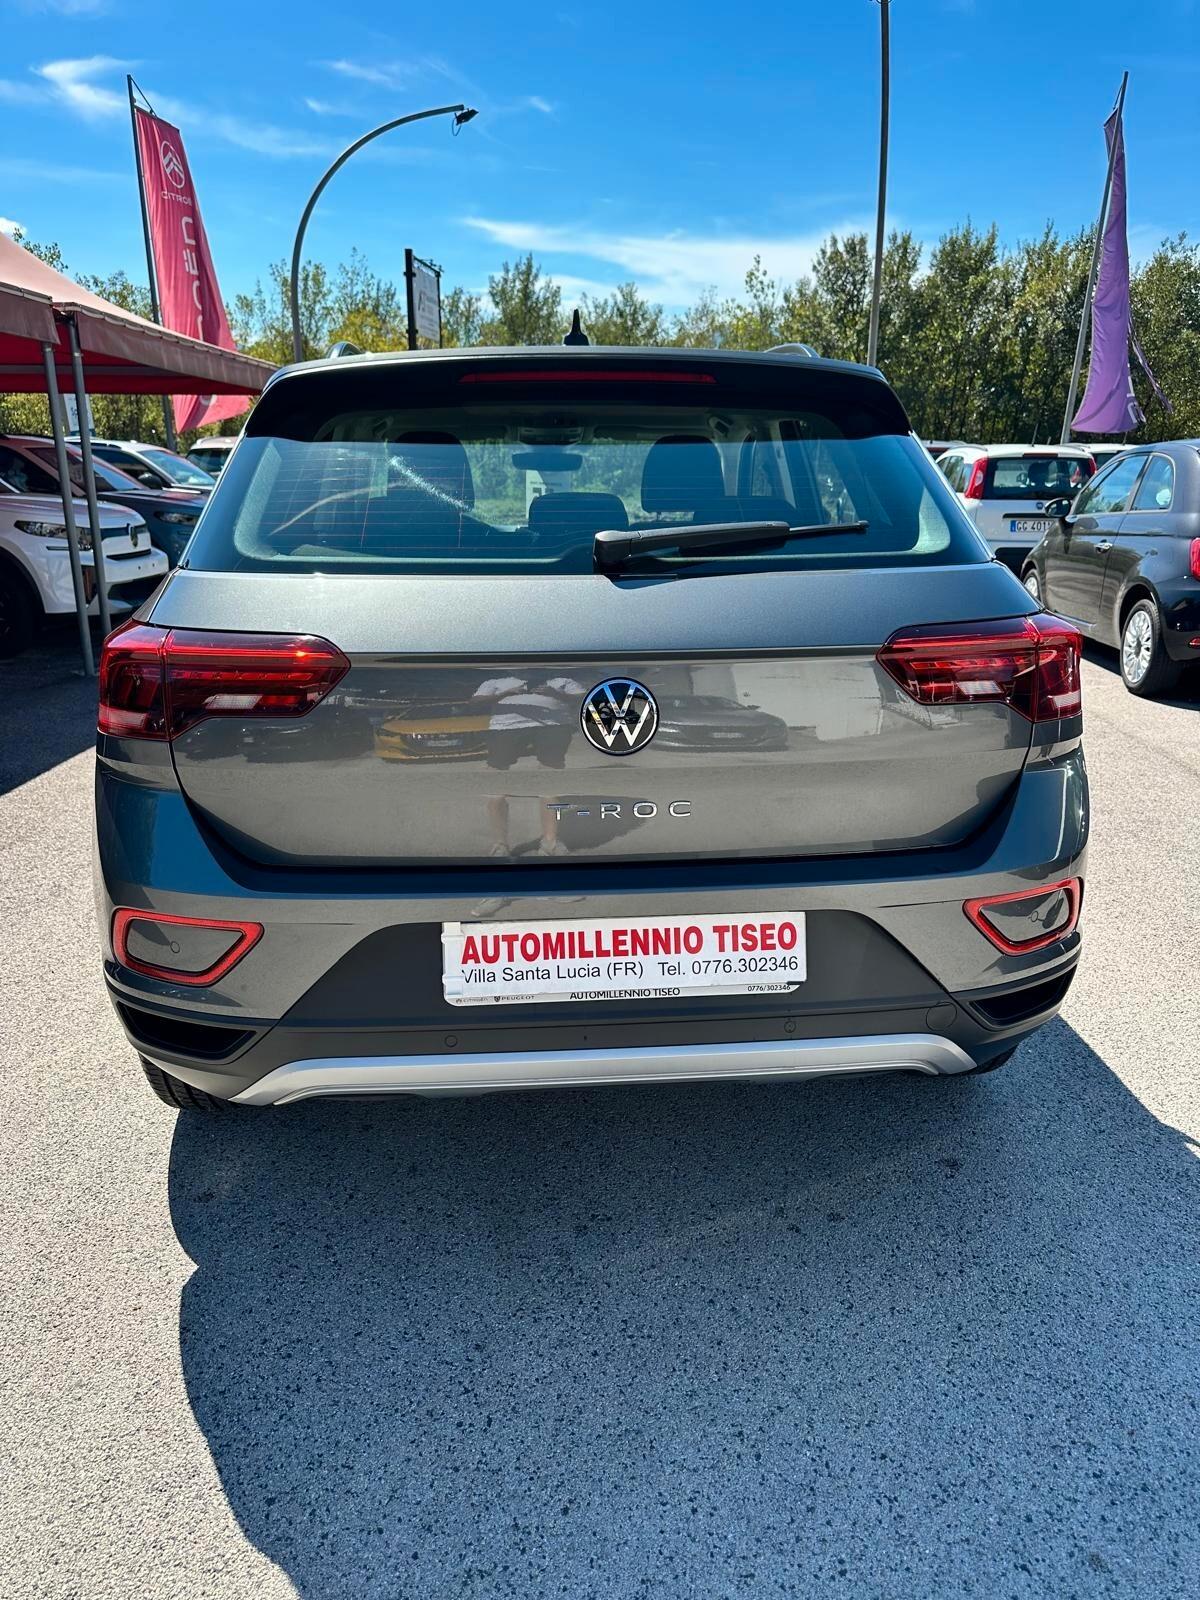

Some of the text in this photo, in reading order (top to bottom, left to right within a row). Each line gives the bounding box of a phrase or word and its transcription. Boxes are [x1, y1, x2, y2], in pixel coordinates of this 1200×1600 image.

[586, 681, 654, 749] VW
[547, 800, 692, 821] T-ROC
[461, 921, 798, 964] AUTOMILLENNIO TISEO
[462, 956, 799, 984] Villa Santa Lucia (FR) Tel. 0776.302346
[569, 987, 681, 1000] AUTOMILLENNIO TISEO
[747, 983, 791, 992] 0776/302346
